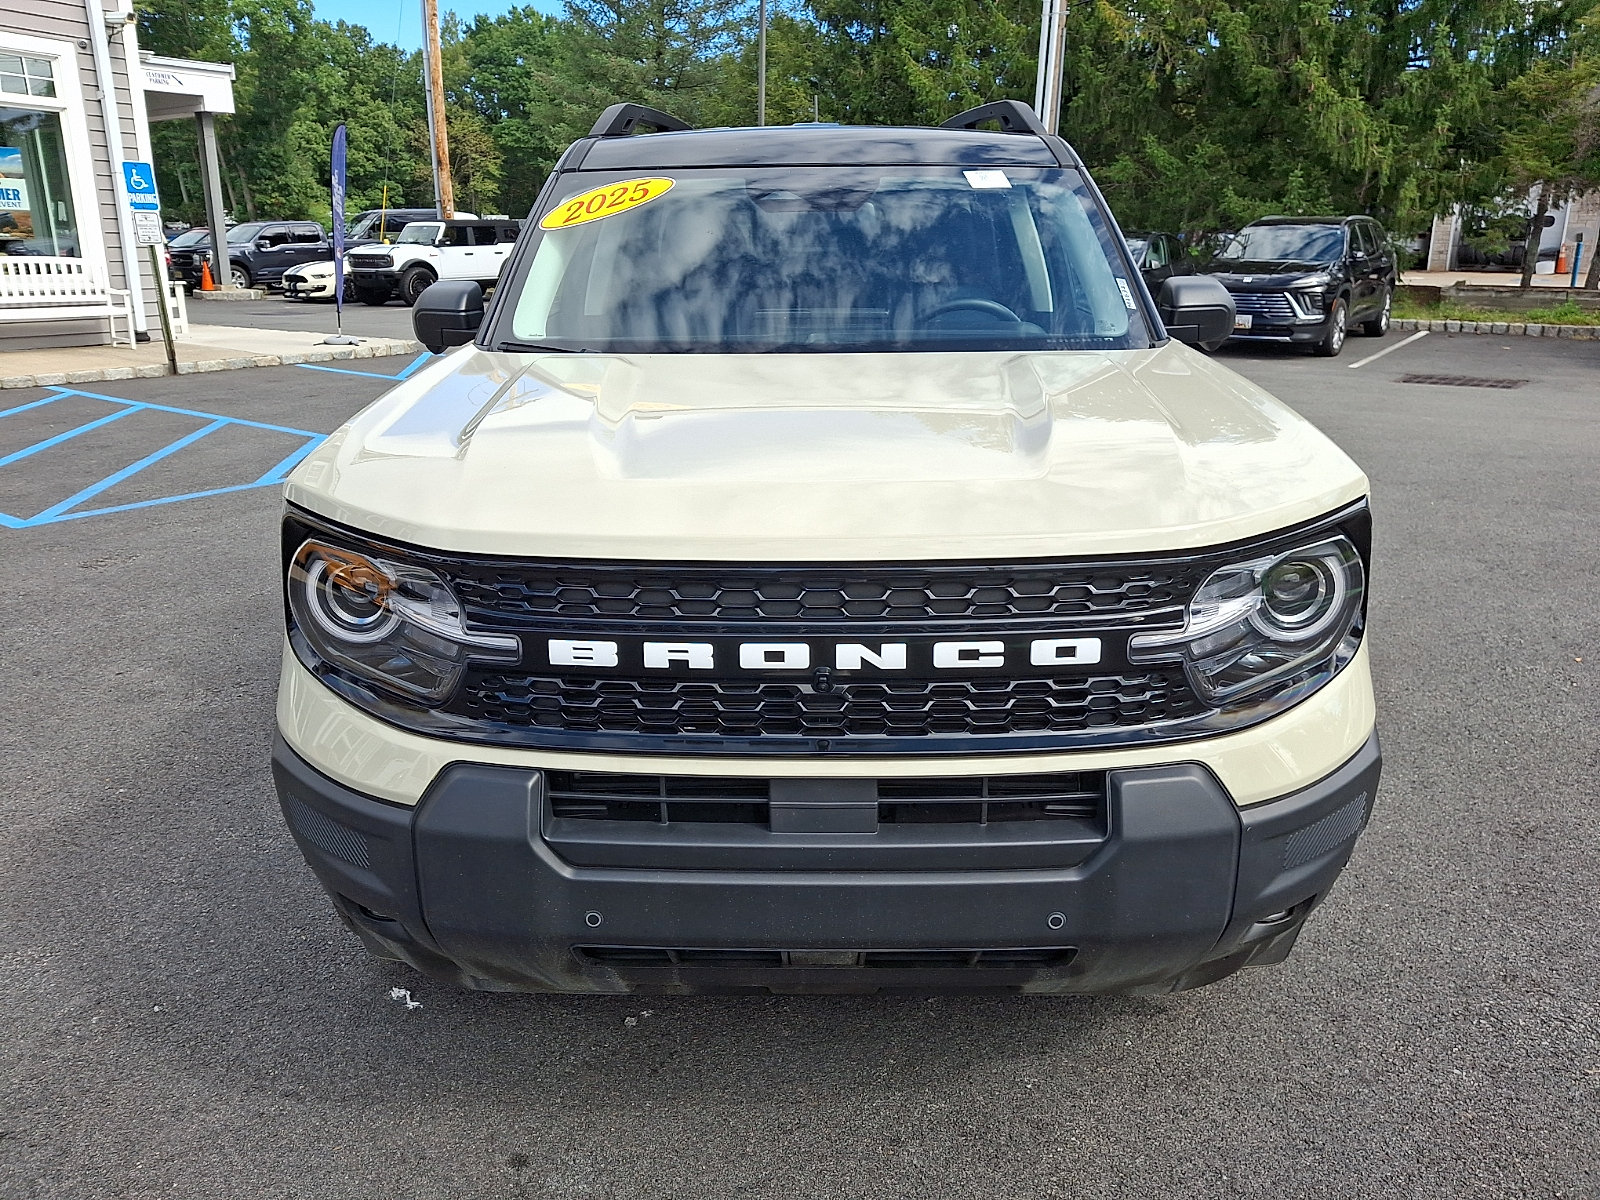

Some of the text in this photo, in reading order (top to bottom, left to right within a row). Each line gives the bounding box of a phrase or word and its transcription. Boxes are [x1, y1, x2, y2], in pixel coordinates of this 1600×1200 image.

[127, 192, 158, 204] PARKING
[562, 180, 652, 224] 2025
[547, 637, 1102, 670] BRONCO
